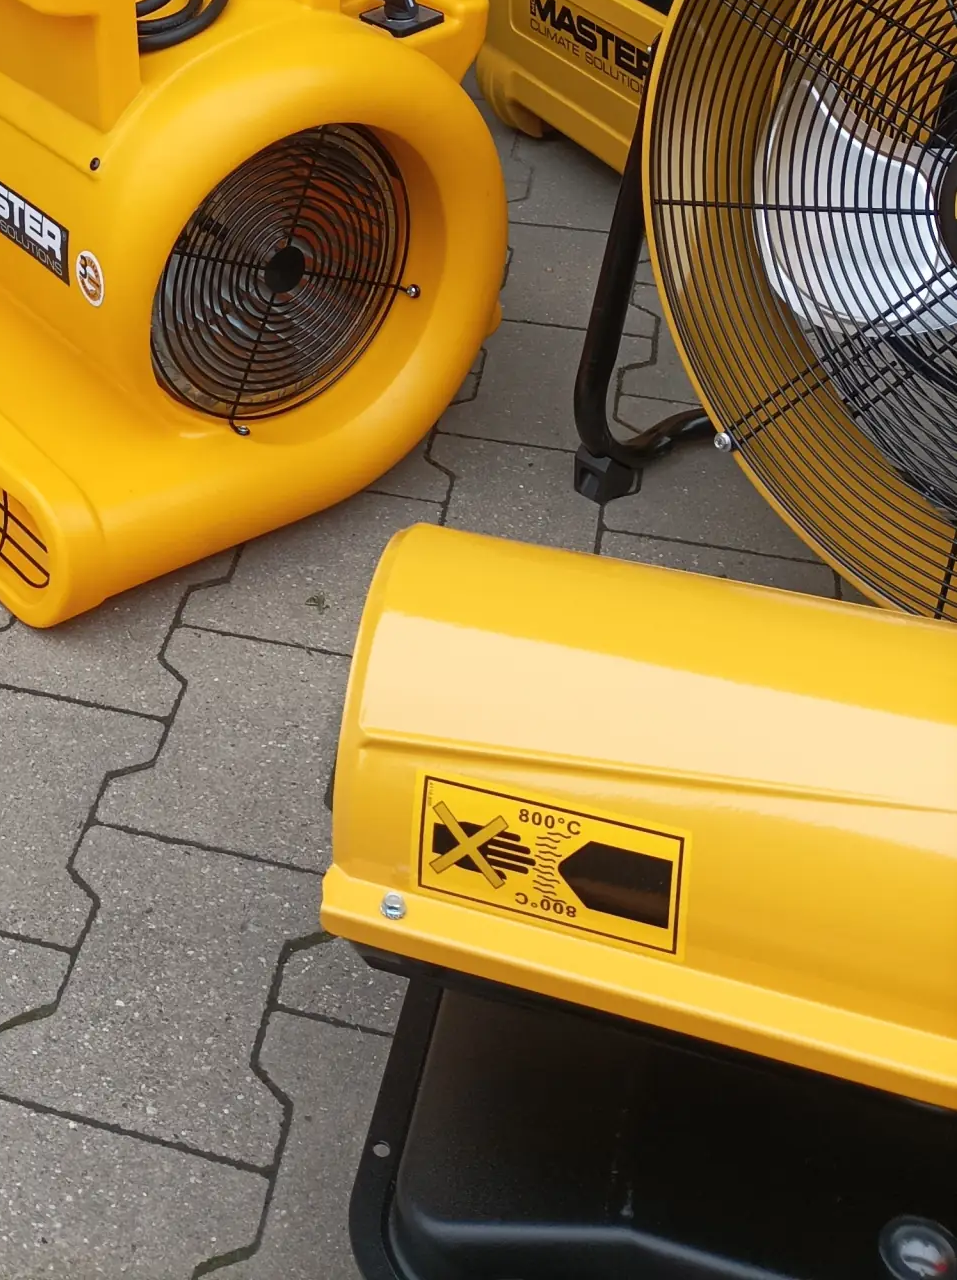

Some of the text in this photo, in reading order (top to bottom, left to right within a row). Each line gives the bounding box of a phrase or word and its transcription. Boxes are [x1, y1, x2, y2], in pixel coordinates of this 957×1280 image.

[530, 18, 644, 95] CLIMATE SOLUTIO
[0, 219, 63, 276] SOLUTIONS
[518, 808, 581, 836] 800°C
[514, 891, 577, 918] 800°C
